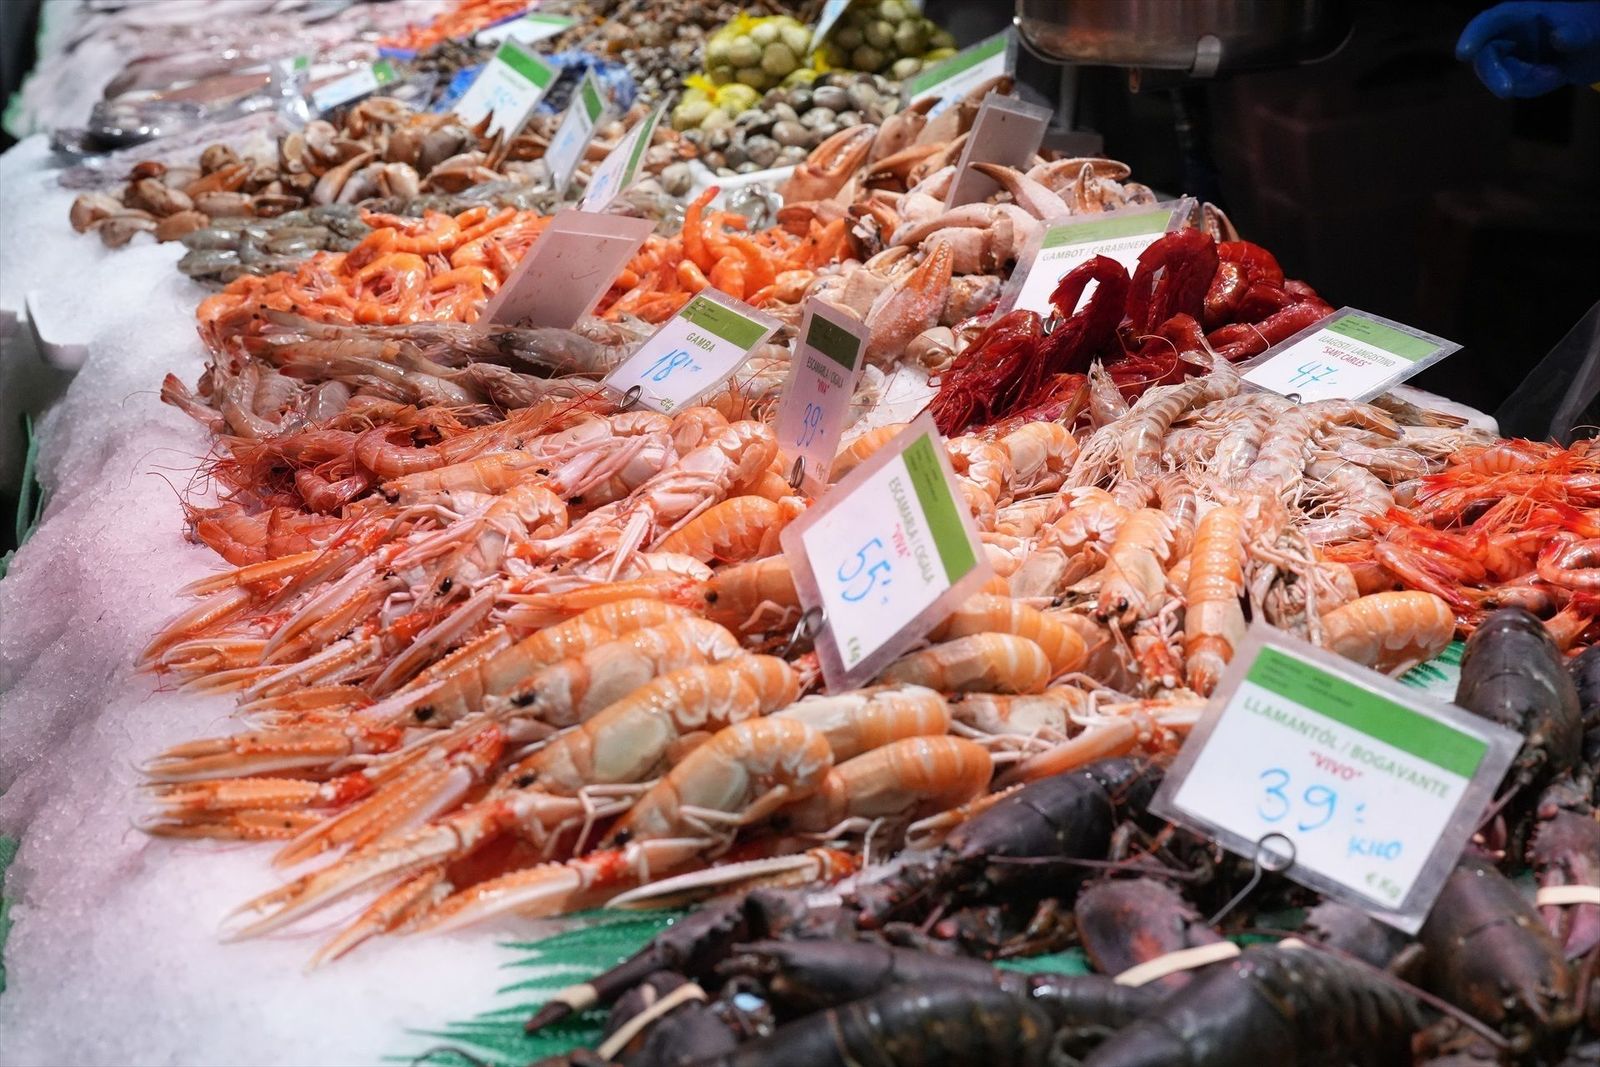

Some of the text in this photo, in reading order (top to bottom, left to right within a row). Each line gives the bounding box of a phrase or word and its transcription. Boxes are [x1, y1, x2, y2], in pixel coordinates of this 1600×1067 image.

[1042, 248, 1085, 262] GAMBOT
[686, 332, 716, 353] GAMBA
[1309, 750, 1364, 781] "VIVO"
[1349, 743, 1451, 799] BOGAVANTE
